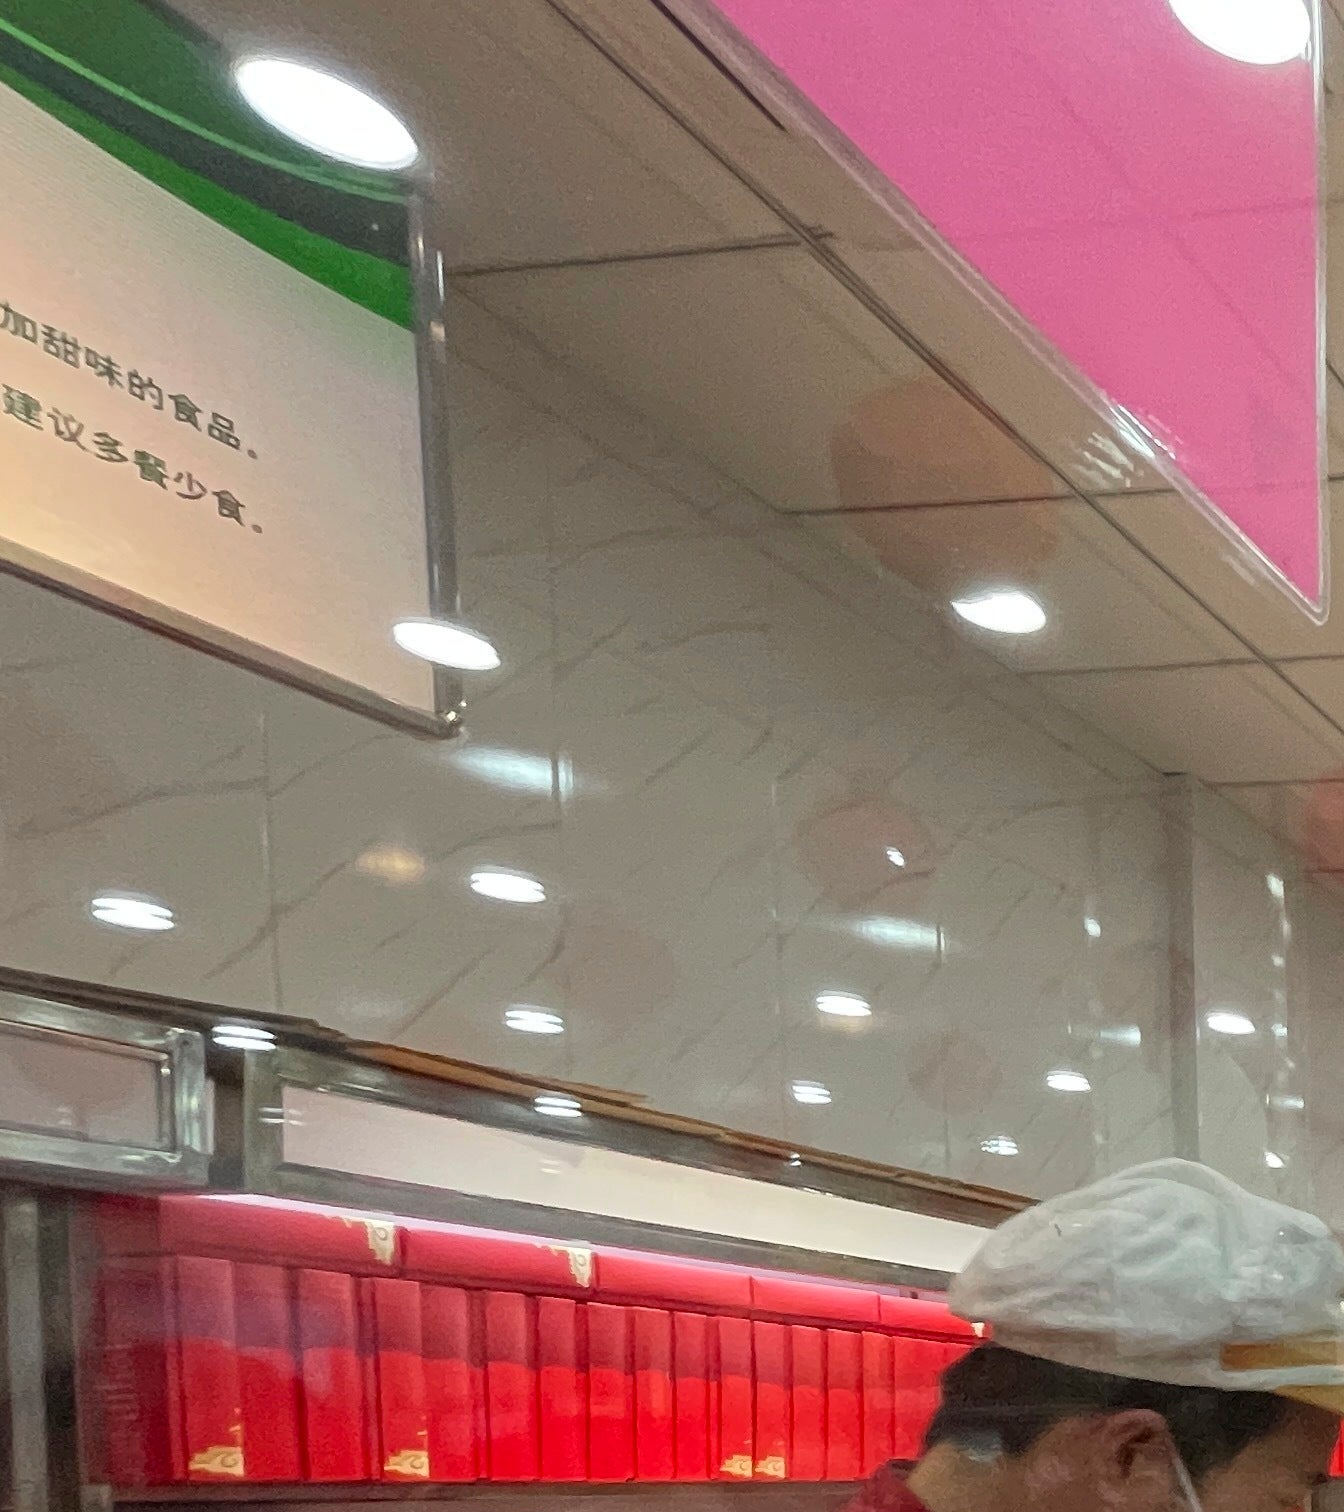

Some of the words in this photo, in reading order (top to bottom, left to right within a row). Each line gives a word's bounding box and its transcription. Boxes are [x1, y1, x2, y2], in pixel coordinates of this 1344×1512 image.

[0, 301, 257, 459] 加甜味的食品。
[2, 383, 263, 534] 建议多餐少食。
